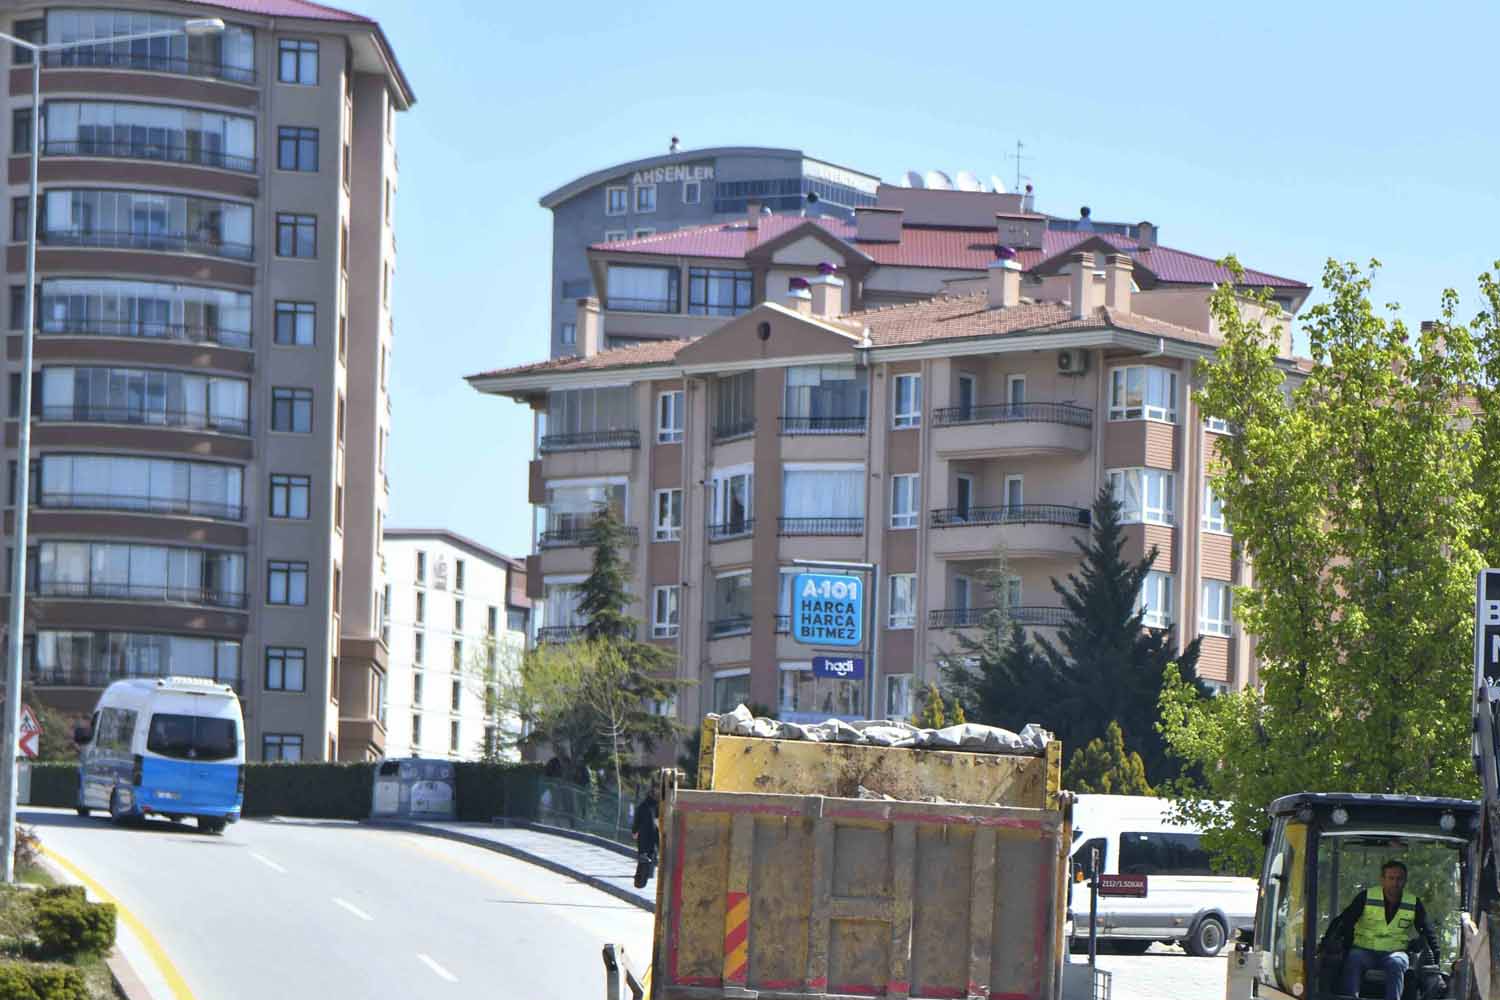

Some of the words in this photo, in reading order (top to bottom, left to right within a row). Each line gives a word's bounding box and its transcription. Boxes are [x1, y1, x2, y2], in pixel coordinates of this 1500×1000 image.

[633, 165, 715, 184] AHSENLER
[801, 599, 855, 614] HARCA
[801, 613, 855, 627] HARCA
